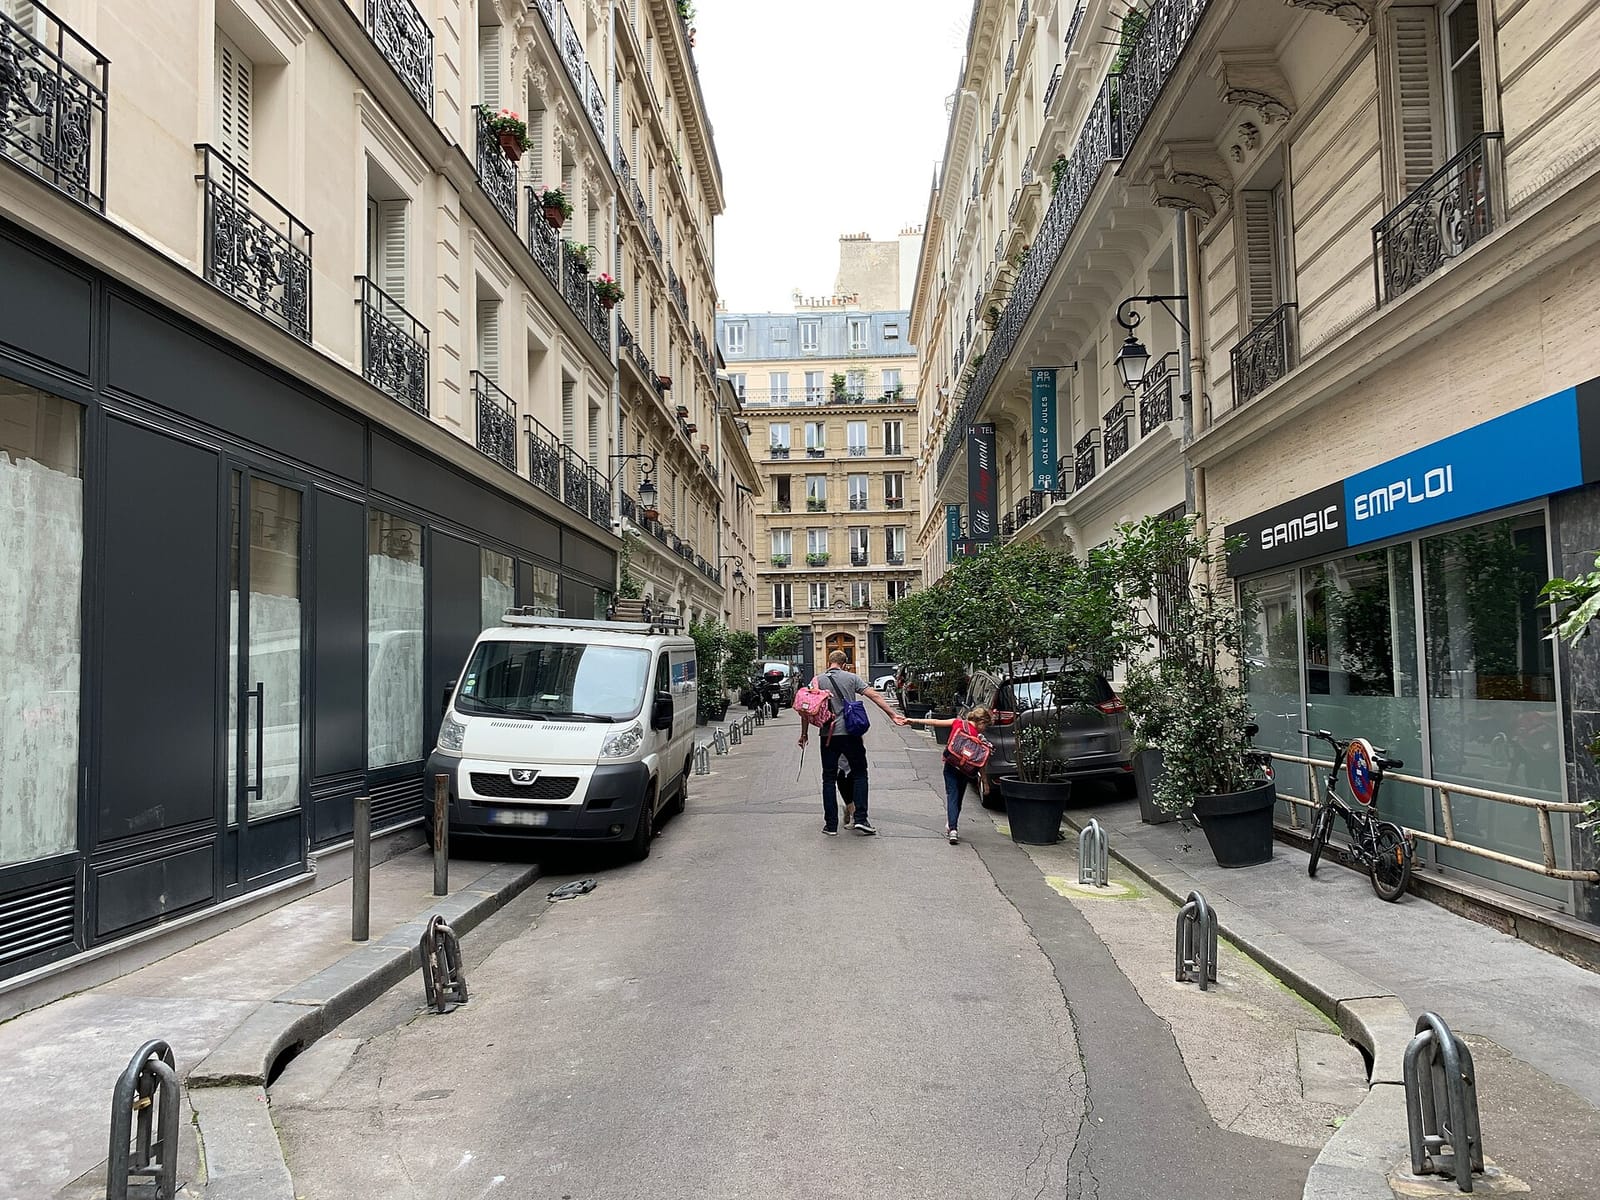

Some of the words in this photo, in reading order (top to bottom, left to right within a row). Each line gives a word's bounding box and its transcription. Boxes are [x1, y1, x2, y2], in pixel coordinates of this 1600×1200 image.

[1039, 426, 1048, 434] &
[1260, 504, 1339, 551] SAMSIC
[1354, 464, 1453, 521] EMPLOI
[973, 510, 990, 534] Cité
